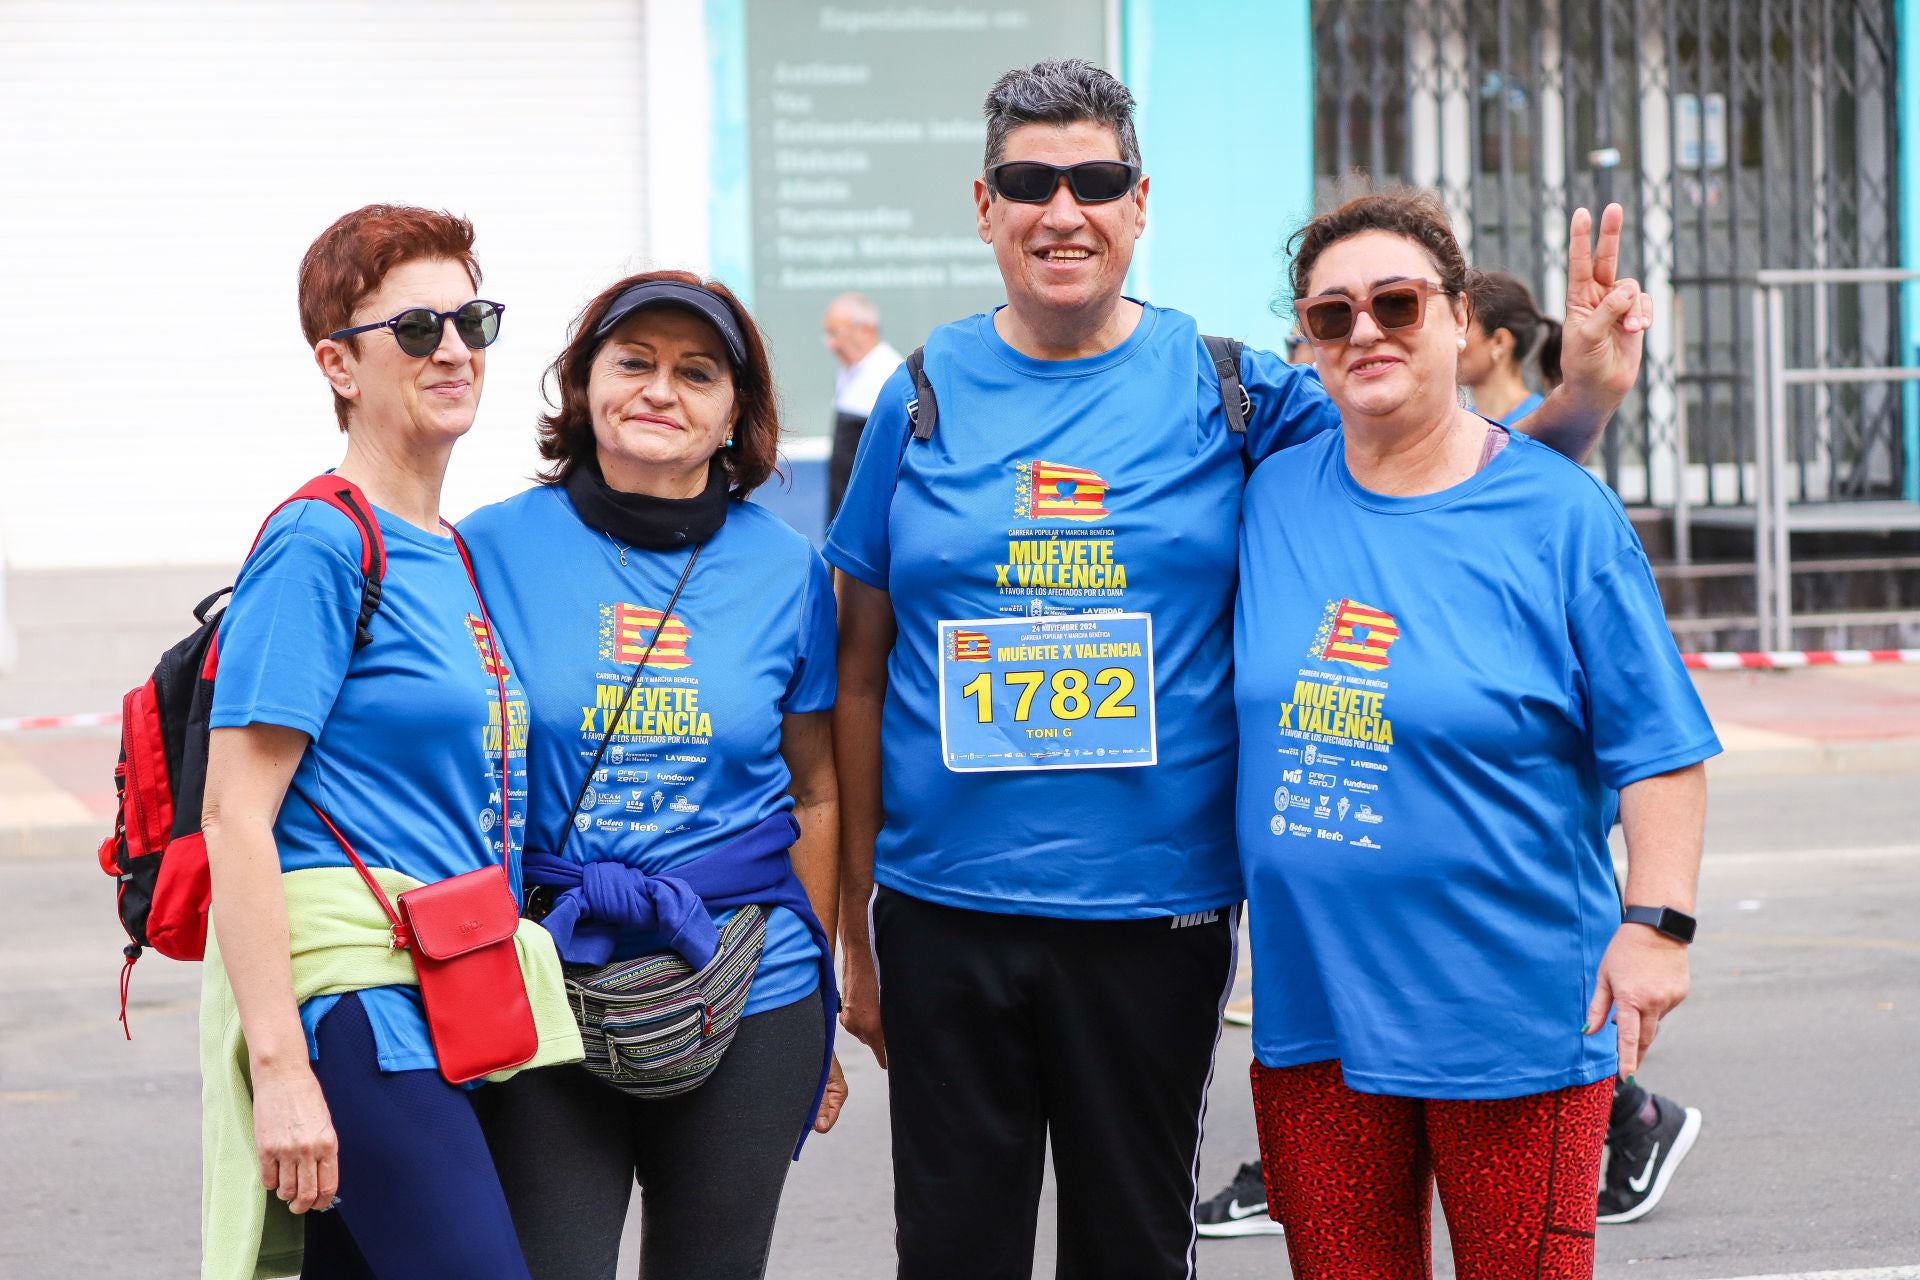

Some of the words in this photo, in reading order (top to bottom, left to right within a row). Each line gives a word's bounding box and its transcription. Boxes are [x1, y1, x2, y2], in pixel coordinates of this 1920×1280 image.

[1089, 528, 1115, 536] BENÉFICA
[1009, 536, 1114, 565] MUÉVETE
[995, 565, 1011, 587] X
[1017, 565, 1127, 588] VALENCIA
[1107, 589, 1123, 597] DANA
[1042, 624, 1078, 632] NOVIEMBRE
[1089, 630, 1110, 638] BENÉFICA
[997, 644, 1058, 662] MUÉVETE
[1062, 644, 1072, 659] X
[1076, 642, 1141, 659] VALENCIA
[596, 672, 619, 681] CARRERA
[674, 676, 699, 684] BENÉFICA
[596, 683, 699, 712] MUÉVETE
[962, 667, 1137, 723] 1782
[1293, 680, 1385, 718] MUÉVETE
[580, 706, 598, 732] X
[602, 709, 713, 737] VALENCIA
[1279, 702, 1294, 728] X
[1298, 706, 1393, 744] VALENCIA
[582, 732, 587, 740] A
[618, 735, 630, 743] LOS
[631, 735, 666, 743] AFECTADOS
[691, 737, 709, 745] DANA
[1025, 729, 1058, 739] TONI
[1063, 728, 1072, 738] G
[1285, 730, 1302, 738] FAVOR
[1311, 733, 1322, 741] LOS
[1323, 735, 1353, 747] AFECTADOS
[1354, 740, 1365, 748] POR
[676, 755, 707, 763] VERDAD
[1360, 761, 1388, 772] VERDAD
[657, 773, 694, 781] fundown
[1308, 779, 1327, 787] zero
[1344, 779, 1379, 791] fundown
[1291, 795, 1310, 803] UCAM
[630, 822, 658, 831] Hero
[1317, 829, 1343, 841] Hero
